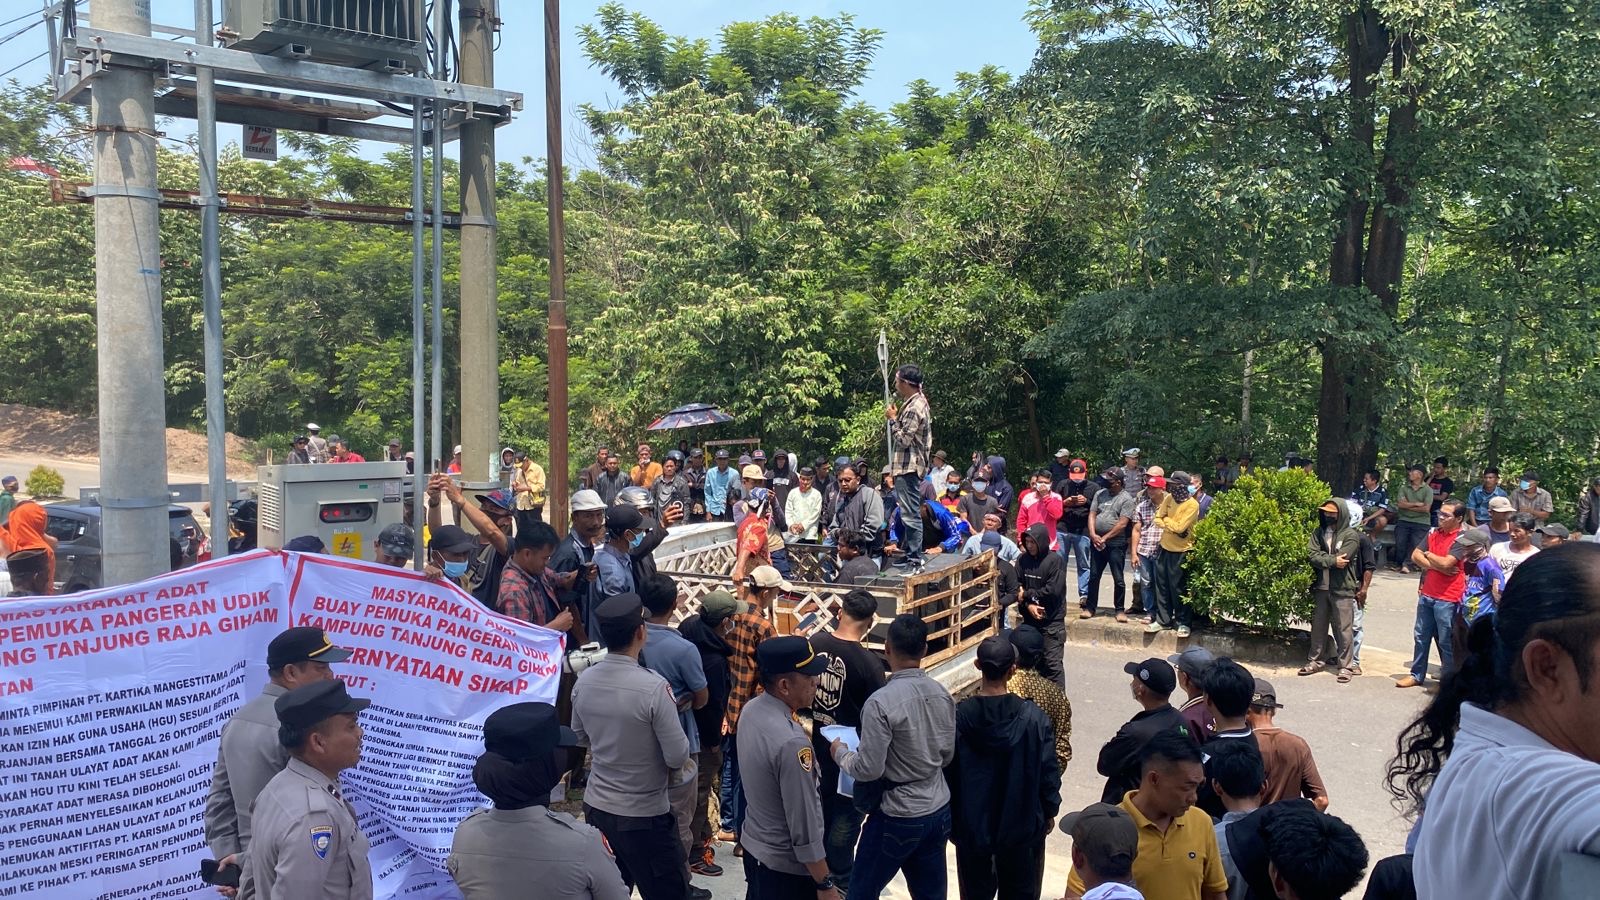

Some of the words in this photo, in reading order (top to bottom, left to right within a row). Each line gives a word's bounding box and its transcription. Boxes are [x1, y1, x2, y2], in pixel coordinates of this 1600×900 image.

[156, 581, 208, 600] ADAT
[371, 586, 481, 623] MASYARAKAT
[102, 598, 217, 632] PANGERAN
[223, 589, 271, 610] UDIK
[0, 646, 36, 668] NG
[43, 631, 150, 660] TANJUNG
[157, 621, 212, 643] RAJA
[218, 608, 278, 632] GIHAM
[298, 613, 385, 638] KAMPUNG
[391, 626, 468, 658] TANJUNG
[471, 647, 513, 670] RAJA
[313, 596, 361, 616] BUAY
[364, 604, 432, 629] PEMUKA
[436, 618, 520, 653] PANGERAN
[521, 644, 551, 663] UDIK
[33, 696, 85, 715] PIMPINAN
[87, 693, 103, 704] PT.
[105, 685, 151, 702] KARTIKA
[153, 670, 228, 693] MANGESTITAMA
[229, 660, 247, 677] ATAU
[468, 674, 529, 695] SIKAP
[0, 742, 24, 753] KAN
[28, 739, 50, 750] IZIN
[53, 733, 75, 747] HAK
[78, 727, 107, 741] GUNA
[110, 720, 146, 735] USAHA
[148, 714, 177, 730] (HGU)
[180, 706, 211, 722] SESUAI
[213, 692, 240, 711] BERITA
[13, 718, 63, 736] MENEMUI
[66, 712, 93, 726] KAMI
[96, 700, 163, 720] PERWAKILAN
[165, 685, 225, 708] MASYARAKAT
[226, 675, 246, 691] ADAT
[424, 715, 457, 727] AKTIFITAS
[56, 745, 106, 763] BERSAMA
[108, 735, 156, 752] TANGGAL
[159, 733, 171, 743] 26
[173, 717, 214, 739] OKTOBER
[360, 734, 405, 749] GOSONGKAN
[426, 746, 449, 757] TANAM
[369, 714, 385, 723] BAIK
[395, 721, 415, 730] LAHAN
[458, 731, 479, 741] SAWIT
[370, 725, 403, 738] KARISMA.
[13, 775, 27, 784] INI
[31, 769, 67, 781] TANAH
[70, 761, 109, 776] ULAYAT
[113, 755, 138, 769] ADAT
[142, 748, 169, 763] AKAN
[172, 741, 194, 755] KAMI
[196, 729, 221, 746] AMBIL
[365, 745, 403, 760] PRODUKTIF
[417, 755, 447, 766] BERIKUT
[367, 757, 391, 768] LAHAN
[411, 765, 437, 775] ULAYAT
[437, 770, 455, 778] ADAT
[31, 786, 53, 797] HGU
[57, 783, 74, 794] ITU
[78, 780, 100, 791] KINI
[103, 771, 136, 787] TELAH
[140, 761, 180, 779] SELESAI.
[57, 798, 83, 810] ADAT
[87, 789, 129, 805] MERASA
[133, 773, 186, 797] DIBOHONGI
[188, 763, 210, 779] OLEH
[347, 772, 361, 780] DAN
[403, 784, 427, 794] LAHAN
[428, 788, 449, 797] TANAH
[359, 765, 399, 780] MENGGANTI
[415, 776, 435, 785] BIAYA
[369, 788, 390, 798] AKSES
[391, 794, 412, 802] JALAN
[421, 796, 442, 804] DALAM
[397, 805, 420, 813] TANAH
[8, 829, 82, 849] PENGGUNAAN
[86, 821, 120, 836] LAHAN
[123, 811, 160, 827] ULAYAT
[163, 803, 187, 818] ADAT
[20, 816, 63, 832] PERNAH
[66, 800, 153, 823] MENYELESAIKAN
[0, 849, 55, 866] NEMUKAN
[58, 838, 111, 856] AKTIFITAS
[115, 835, 129, 845] PT.
[132, 822, 176, 841] KARISMA
[178, 818, 188, 827] DI
[369, 839, 385, 848] LUAR
[420, 845, 437, 853] UDIK
[0, 863, 57, 882] ILAKUKAN
[60, 856, 93, 870] MESKI
[96, 841, 159, 862] PERINGATAN
[20, 882, 34, 893] KE
[38, 875, 70, 889] PIHAK
[73, 871, 87, 882] PT.
[91, 862, 137, 877] KARISMA
[139, 849, 179, 868] SEPERTI
